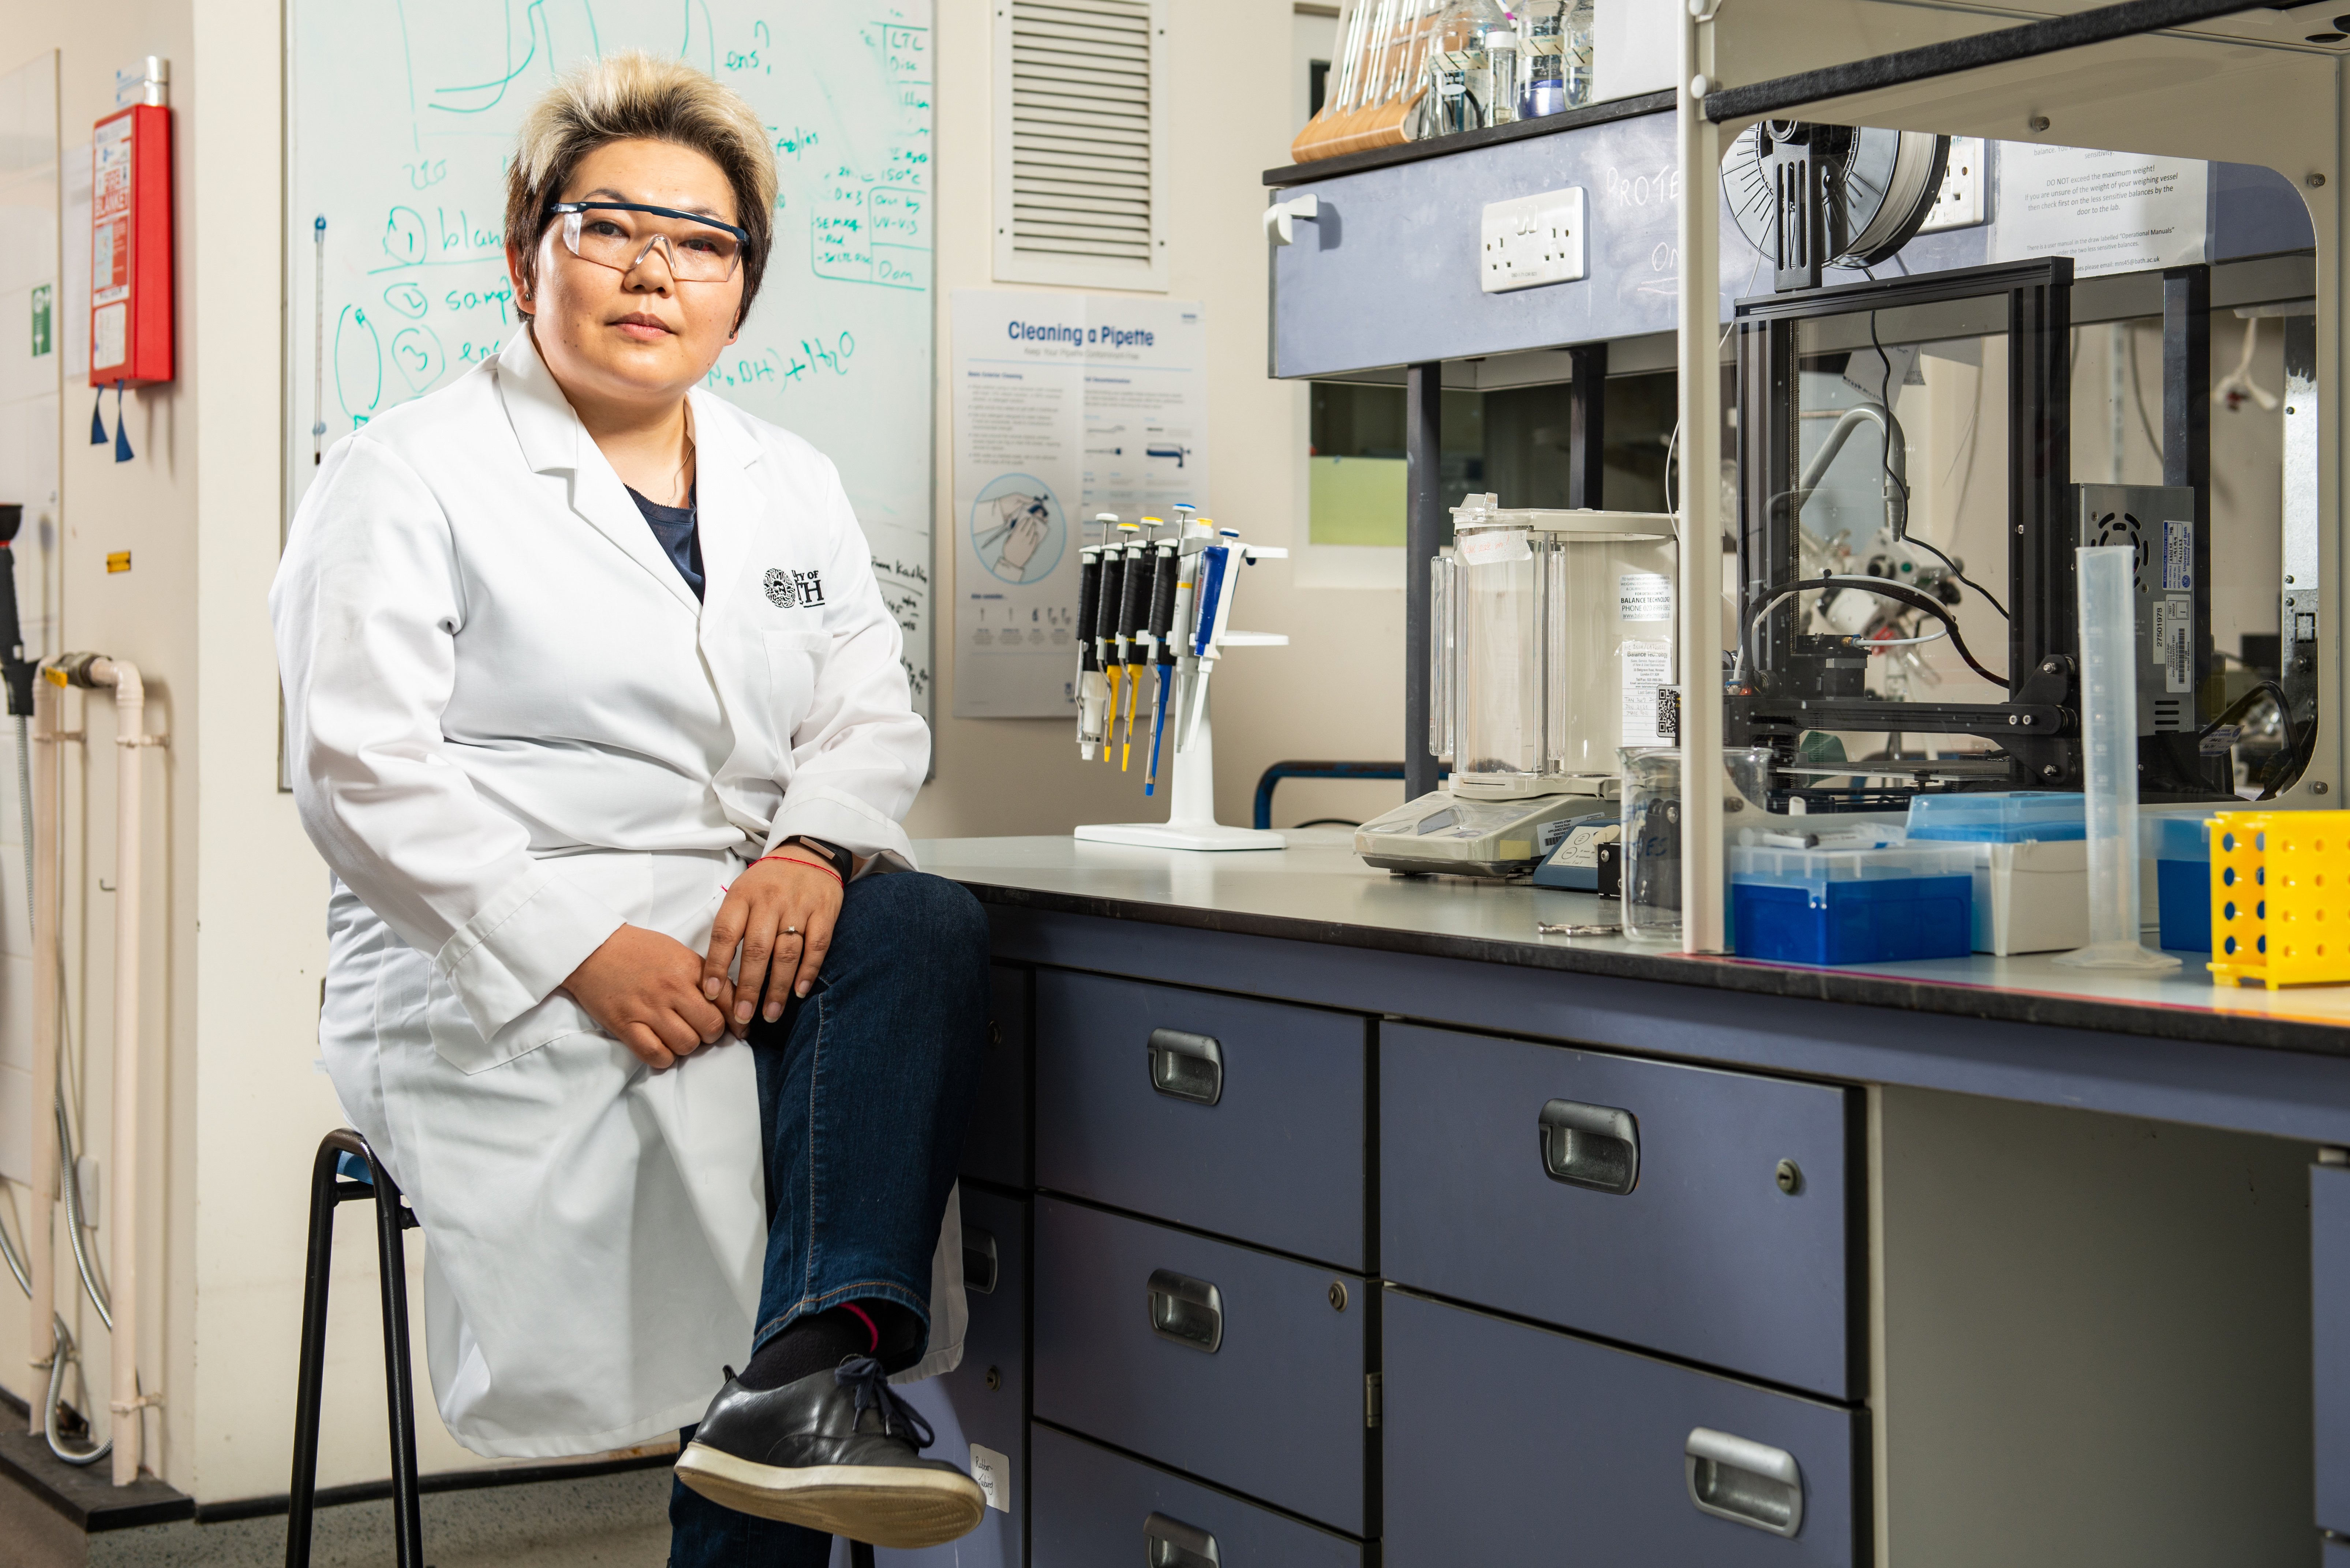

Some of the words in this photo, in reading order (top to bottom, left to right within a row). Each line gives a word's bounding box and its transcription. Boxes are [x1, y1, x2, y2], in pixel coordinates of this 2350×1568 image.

[2034, 147, 2056, 155] balance.
[2085, 150, 2114, 158] sensitivity.
[2071, 175, 2089, 183] exceed
[2103, 169, 2131, 178] maximum
[2133, 165, 2155, 175] weight!
[2091, 183, 2109, 191] weight
[2118, 181, 2131, 189] your
[2133, 177, 2159, 185] weighing
[2160, 173, 2178, 181] vessel
[2042, 201, 2057, 209] check
[2103, 192, 2127, 201] sensitive
[2129, 189, 2153, 197] balances
[438, 207, 504, 251] blan
[2085, 263, 2099, 271] please
[2115, 256, 2160, 267] mns45@bath.ac.uk
[446, 276, 513, 325] samp
[1007, 320, 1083, 347] Cleaning
[1088, 329, 1097, 343] a
[1101, 325, 1154, 348] Pipette
[807, 570, 819, 579] OF
[976, 1456, 992, 1471] Rubber
